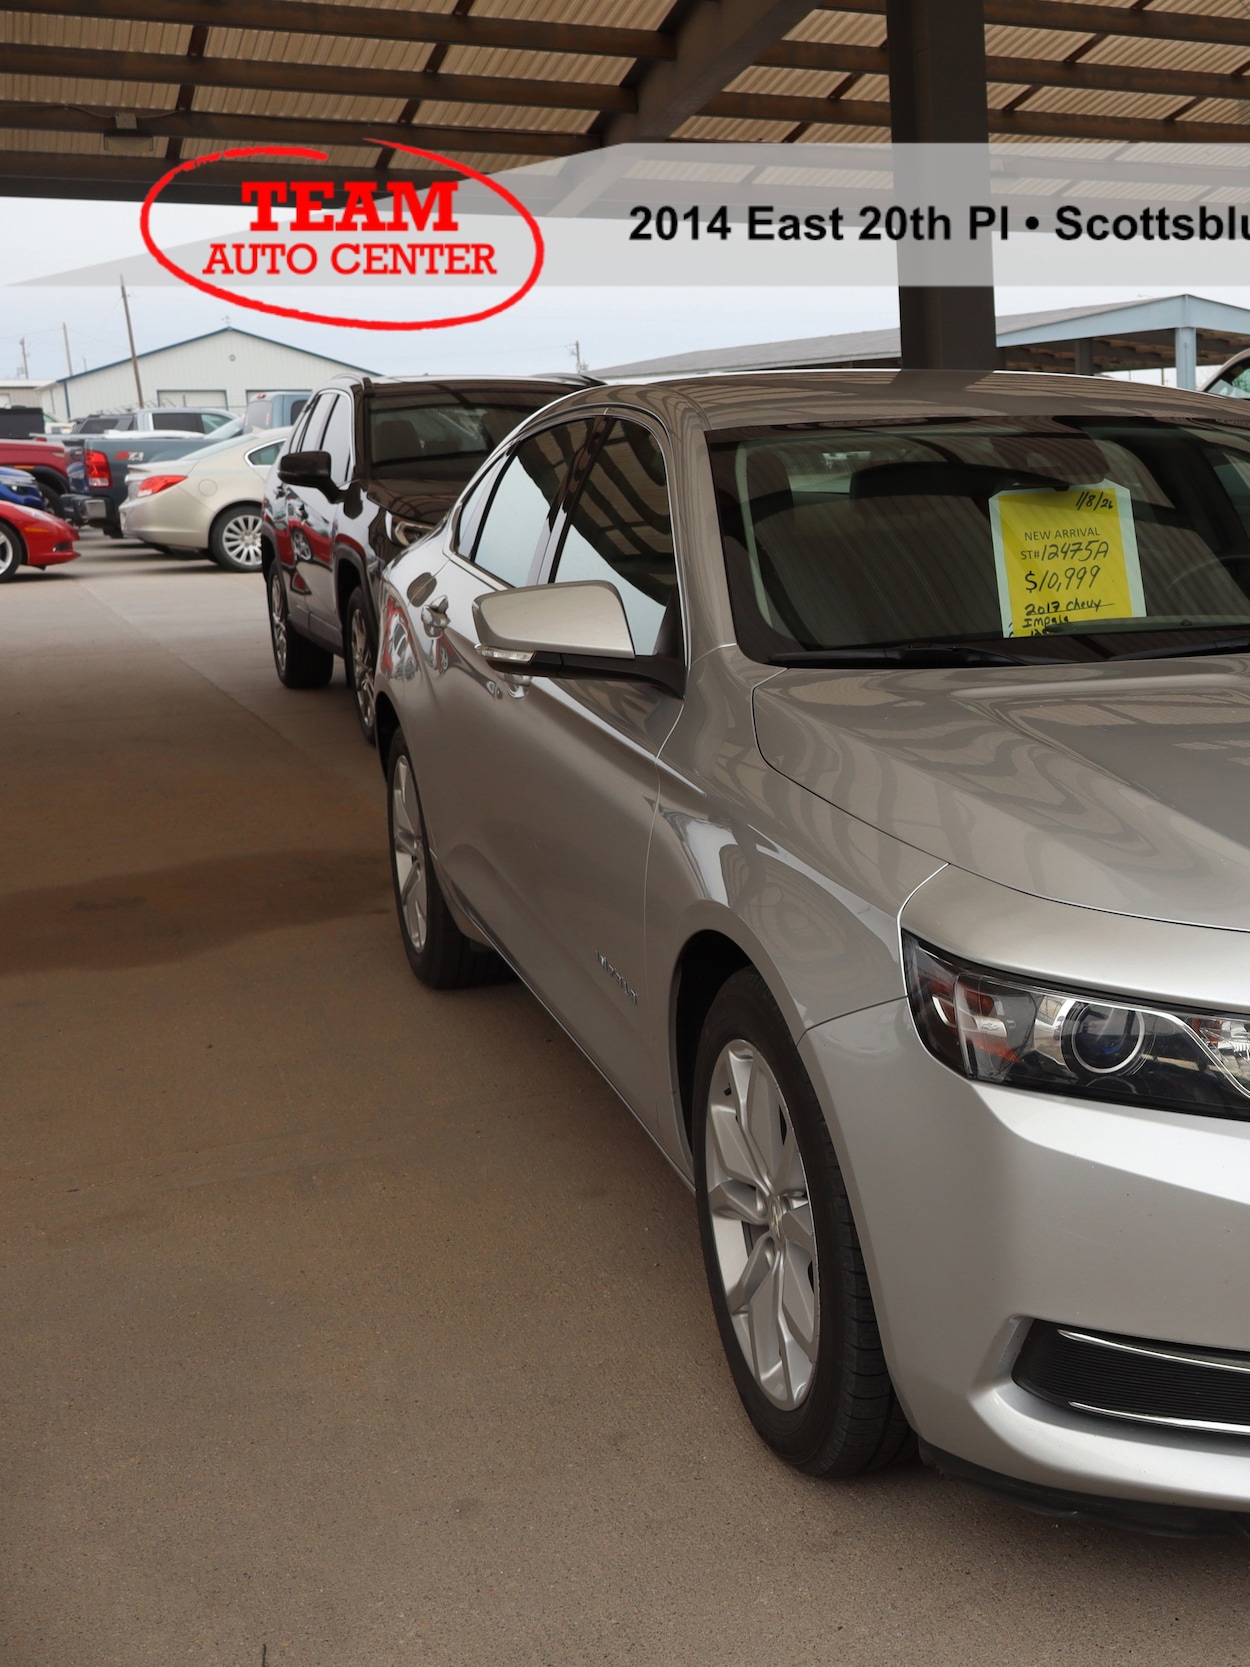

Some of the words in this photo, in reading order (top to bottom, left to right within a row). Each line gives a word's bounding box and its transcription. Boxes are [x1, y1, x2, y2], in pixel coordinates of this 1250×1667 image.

[1024, 531, 1051, 541] NEW
[1054, 527, 1101, 539] ARRIVAL
[1024, 565, 1101, 593] $10,999
[1024, 601, 1061, 617] 2017
